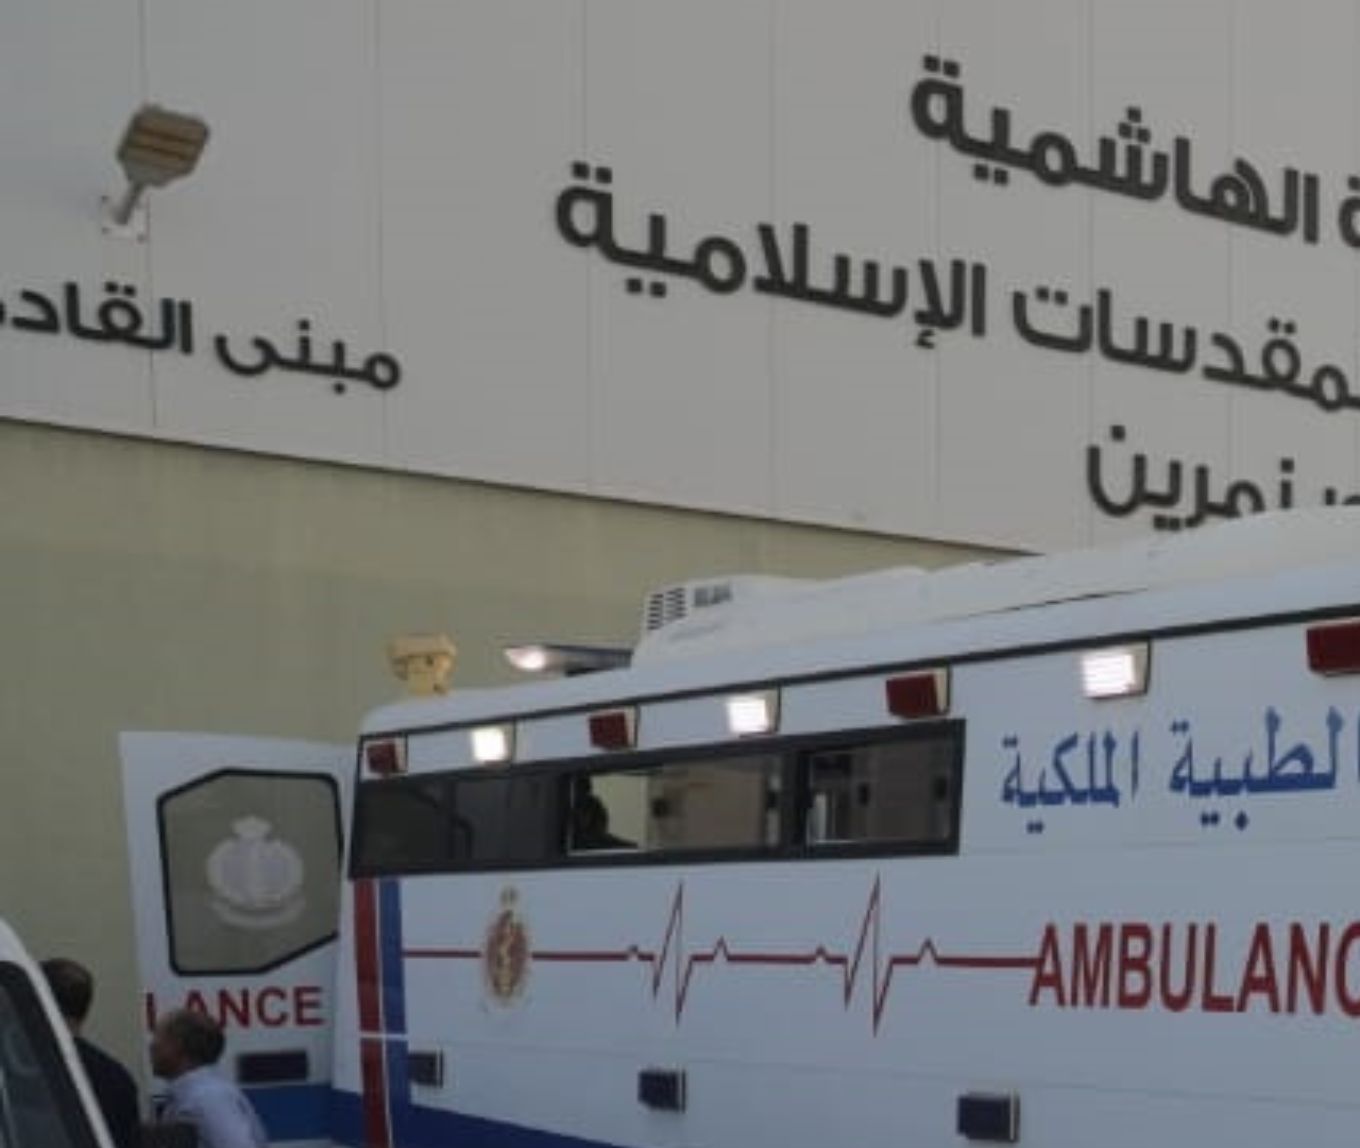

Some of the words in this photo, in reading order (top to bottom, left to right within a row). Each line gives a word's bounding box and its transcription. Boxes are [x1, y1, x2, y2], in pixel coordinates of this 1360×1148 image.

[909, 54, 1320, 245] الهاشمية
[554, 161, 987, 350] الإسلامية
[0, 280, 195, 356] القاد
[213, 318, 402, 395] مبنى
[1001, 729, 1140, 834] الملكية
